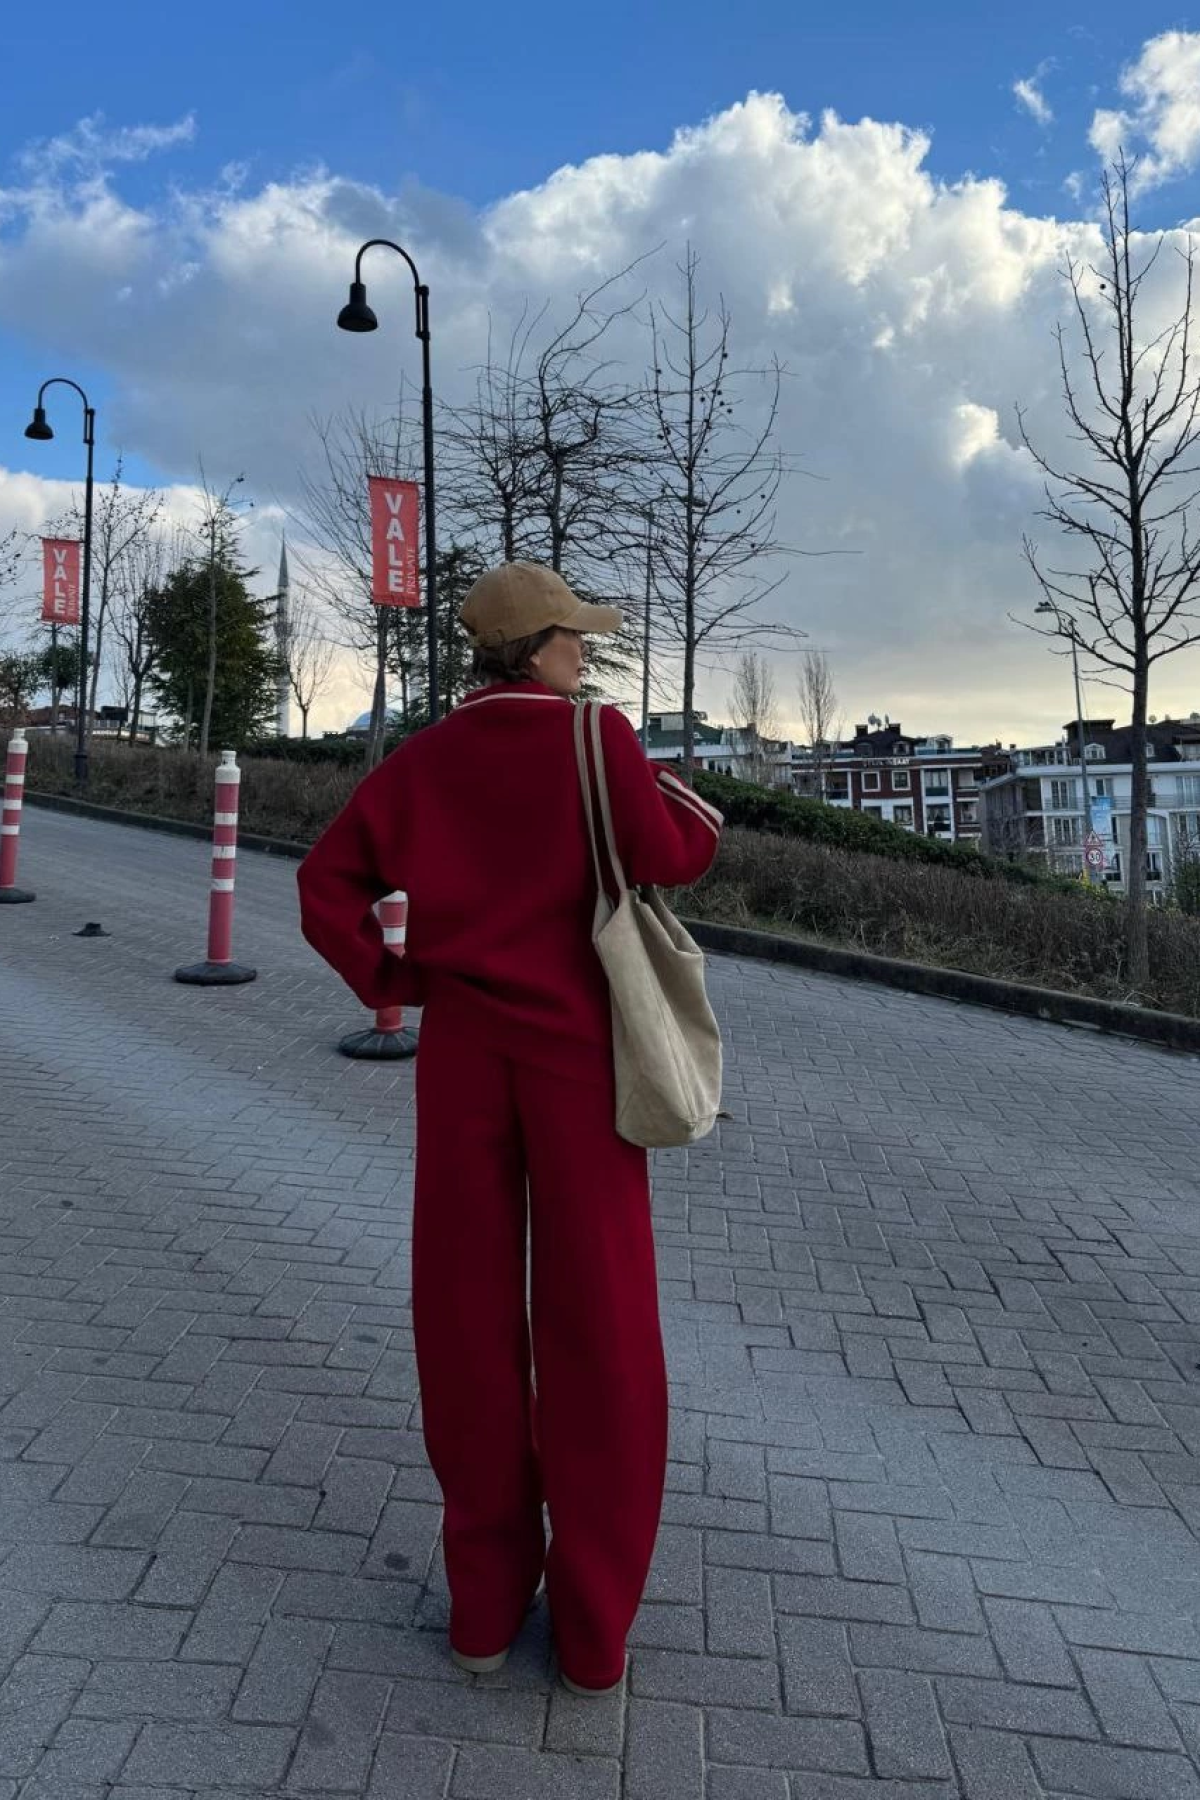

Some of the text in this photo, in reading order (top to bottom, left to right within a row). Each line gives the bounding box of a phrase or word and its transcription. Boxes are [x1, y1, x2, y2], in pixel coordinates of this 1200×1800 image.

[384, 491, 405, 593] VALE
[406, 545, 416, 595] PRIVATE
[53, 547, 67, 614] VALE
